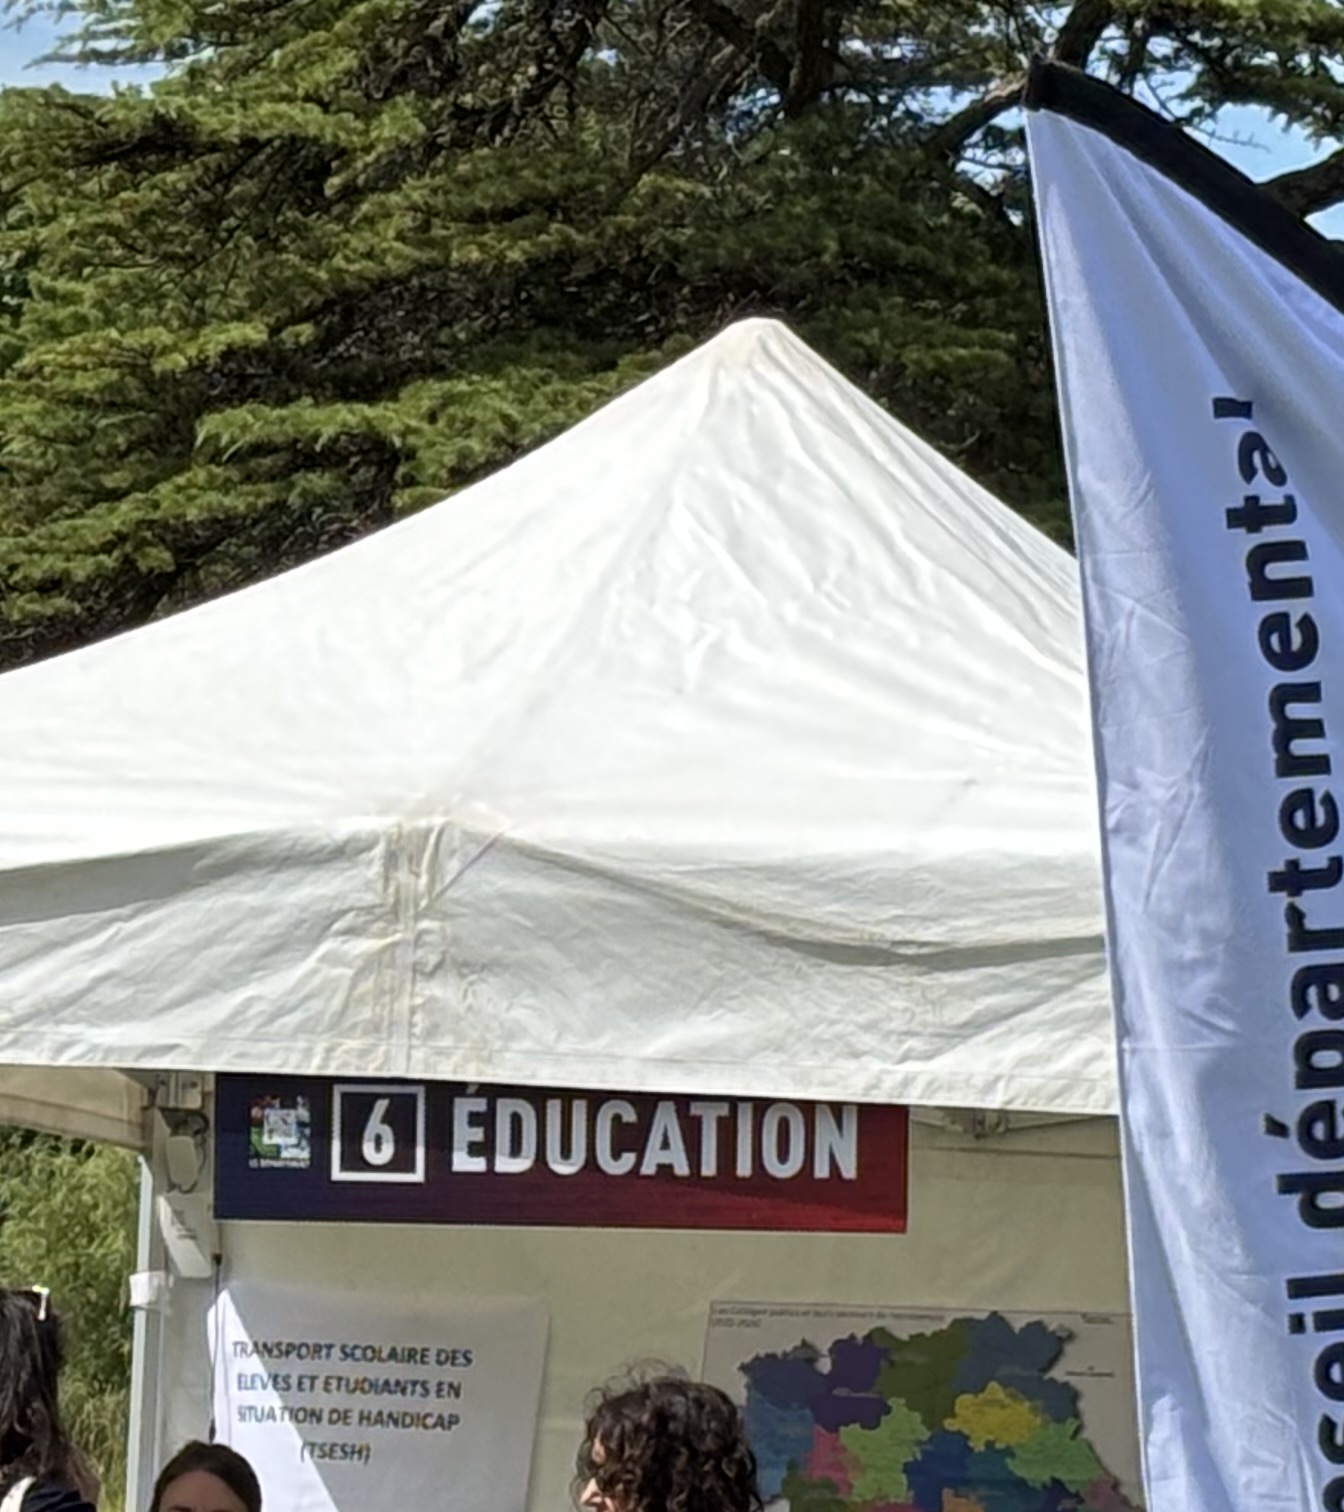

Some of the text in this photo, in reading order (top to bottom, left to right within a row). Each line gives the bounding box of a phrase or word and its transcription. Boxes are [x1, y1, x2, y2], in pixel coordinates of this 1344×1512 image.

[361, 1084, 857, 1180] 6 ÉDUCATION
[232, 1340, 473, 1368] TRANSPORT SCOLAIRE DES
[296, 1374, 319, 1393] ET
[322, 1375, 431, 1399] ETUDIANTS
[435, 1380, 462, 1400] EN
[236, 1405, 461, 1432] SITUATION DE HANDICAP
[300, 1441, 372, 1466] (TSESH)
